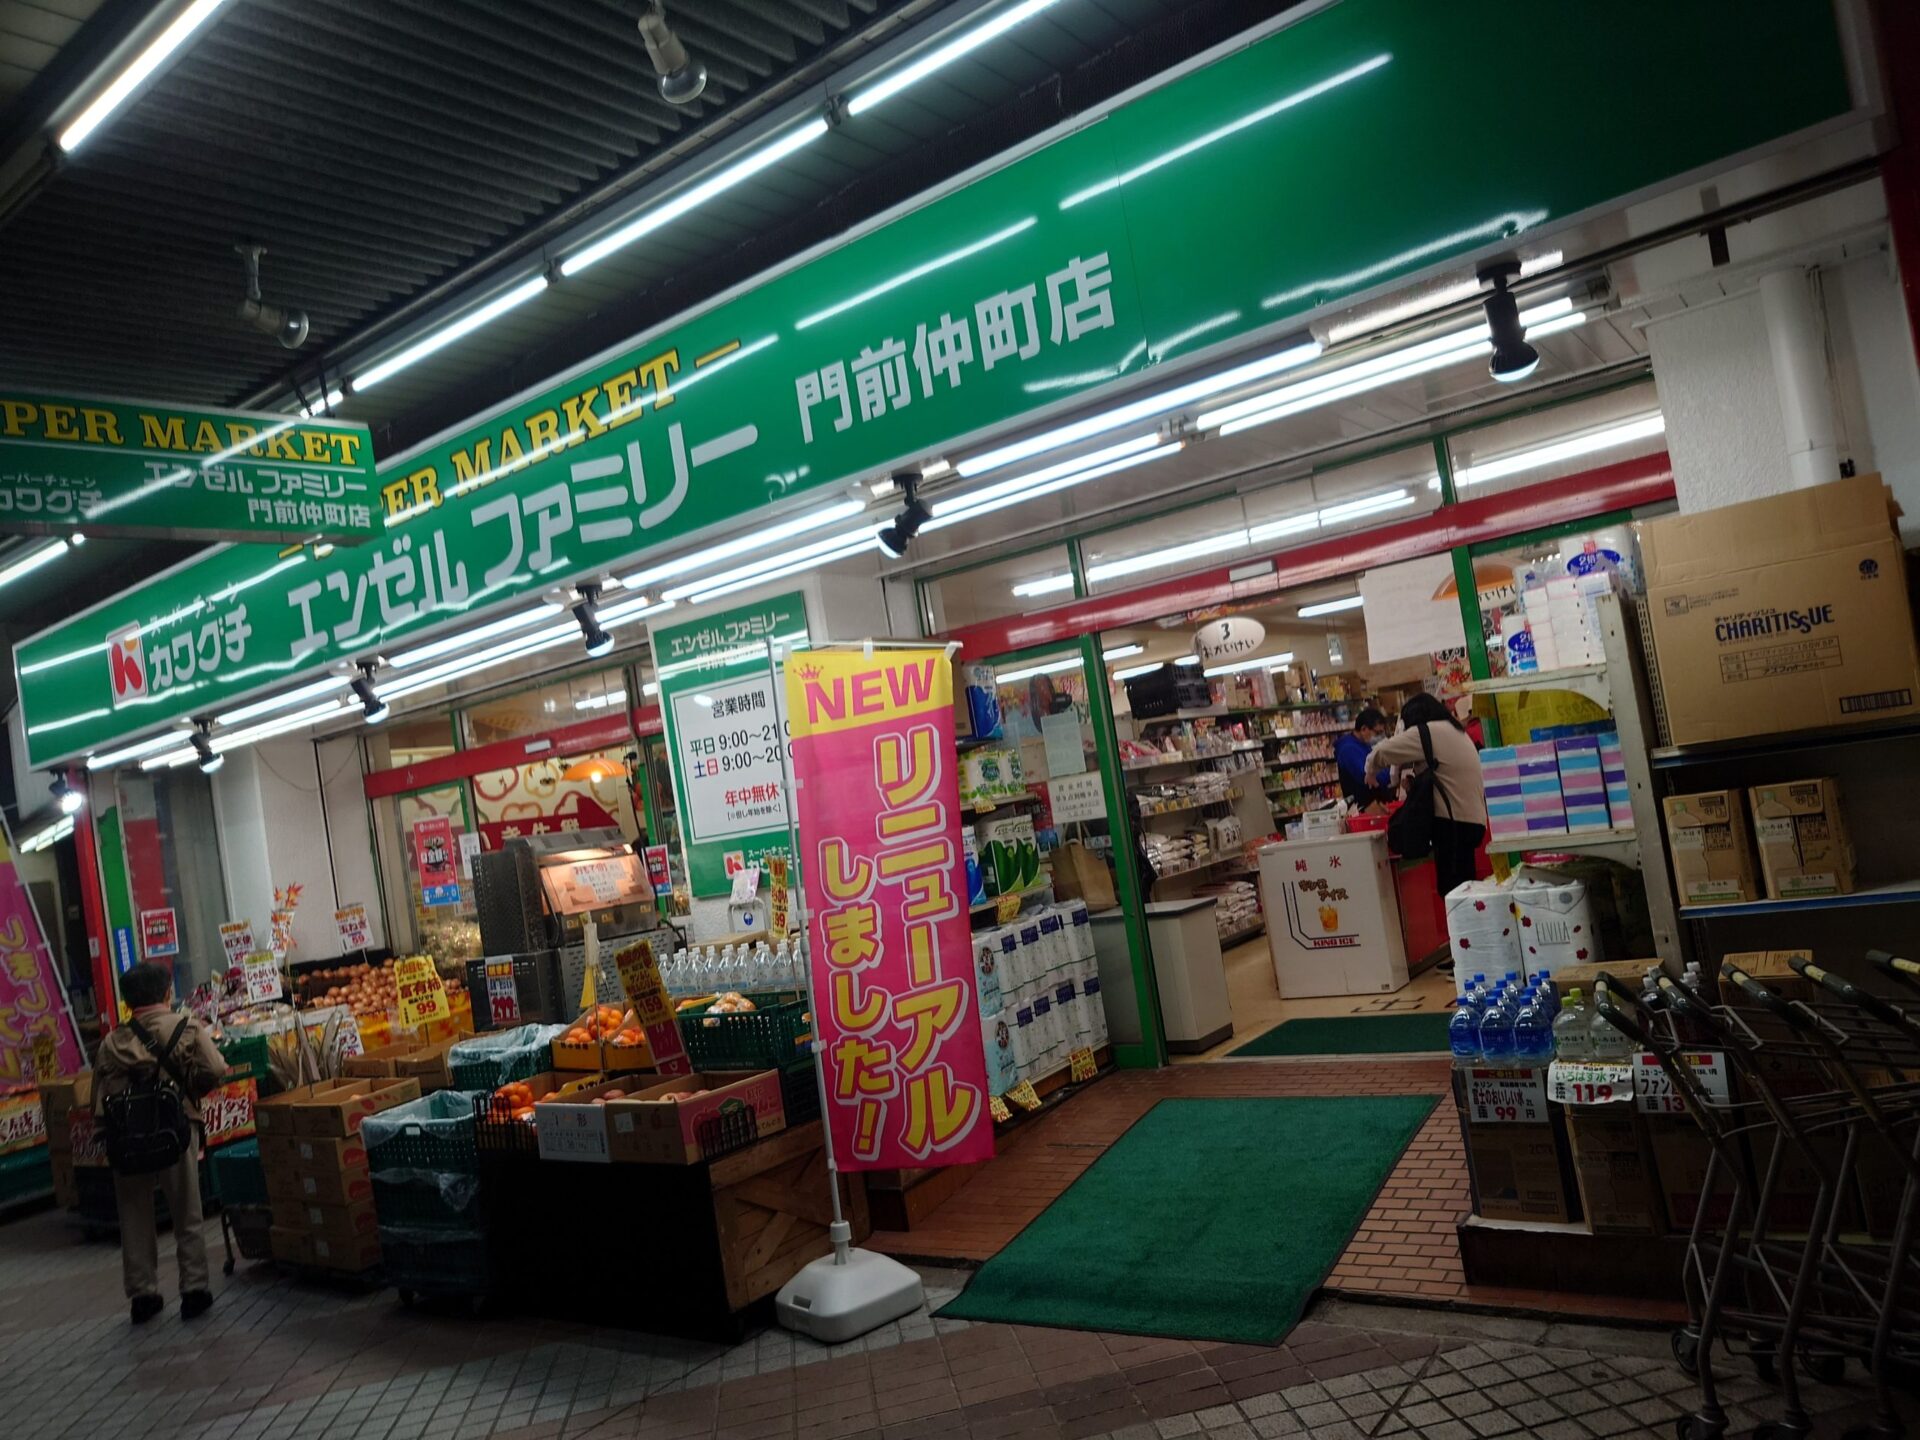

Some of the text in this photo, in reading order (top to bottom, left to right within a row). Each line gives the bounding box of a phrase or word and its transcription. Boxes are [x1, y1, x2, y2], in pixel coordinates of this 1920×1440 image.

[795, 252, 1115, 443] 門前仲町店
[450, 348, 680, 498] MARKET
[139, 414, 360, 465] MARKET
[144, 461, 367, 499] エンゼル ファミリー
[248, 497, 371, 528] 門前仲町店
[287, 421, 758, 657] エンゼル ファミリー
[671, 628, 724, 657] エンゼル
[725, 611, 790, 642] ファミリー
[1221, 622, 1231, 641] 3
[1715, 604, 1835, 642] CHARITISSUE
[150, 604, 252, 691] カワグチ
[711, 690, 766, 719] 営業時間
[805, 658, 936, 724] NEW
[690, 737, 716, 757] 平日
[694, 757, 719, 779] 土日
[725, 782, 780, 808] 年中無休
[876, 723, 980, 1161] リニューアル
[1313, 937, 1356, 948] KING ICE
[247, 967, 278, 982] じゃがいも
[416, 1000, 437, 1015] 99
[1556, 1071, 1607, 1082] いろはす水
[1472, 1088, 1524, 1106] 富士のおいしい水
[1573, 1083, 1613, 1102] 119
[1495, 1106, 1516, 1120] 99
